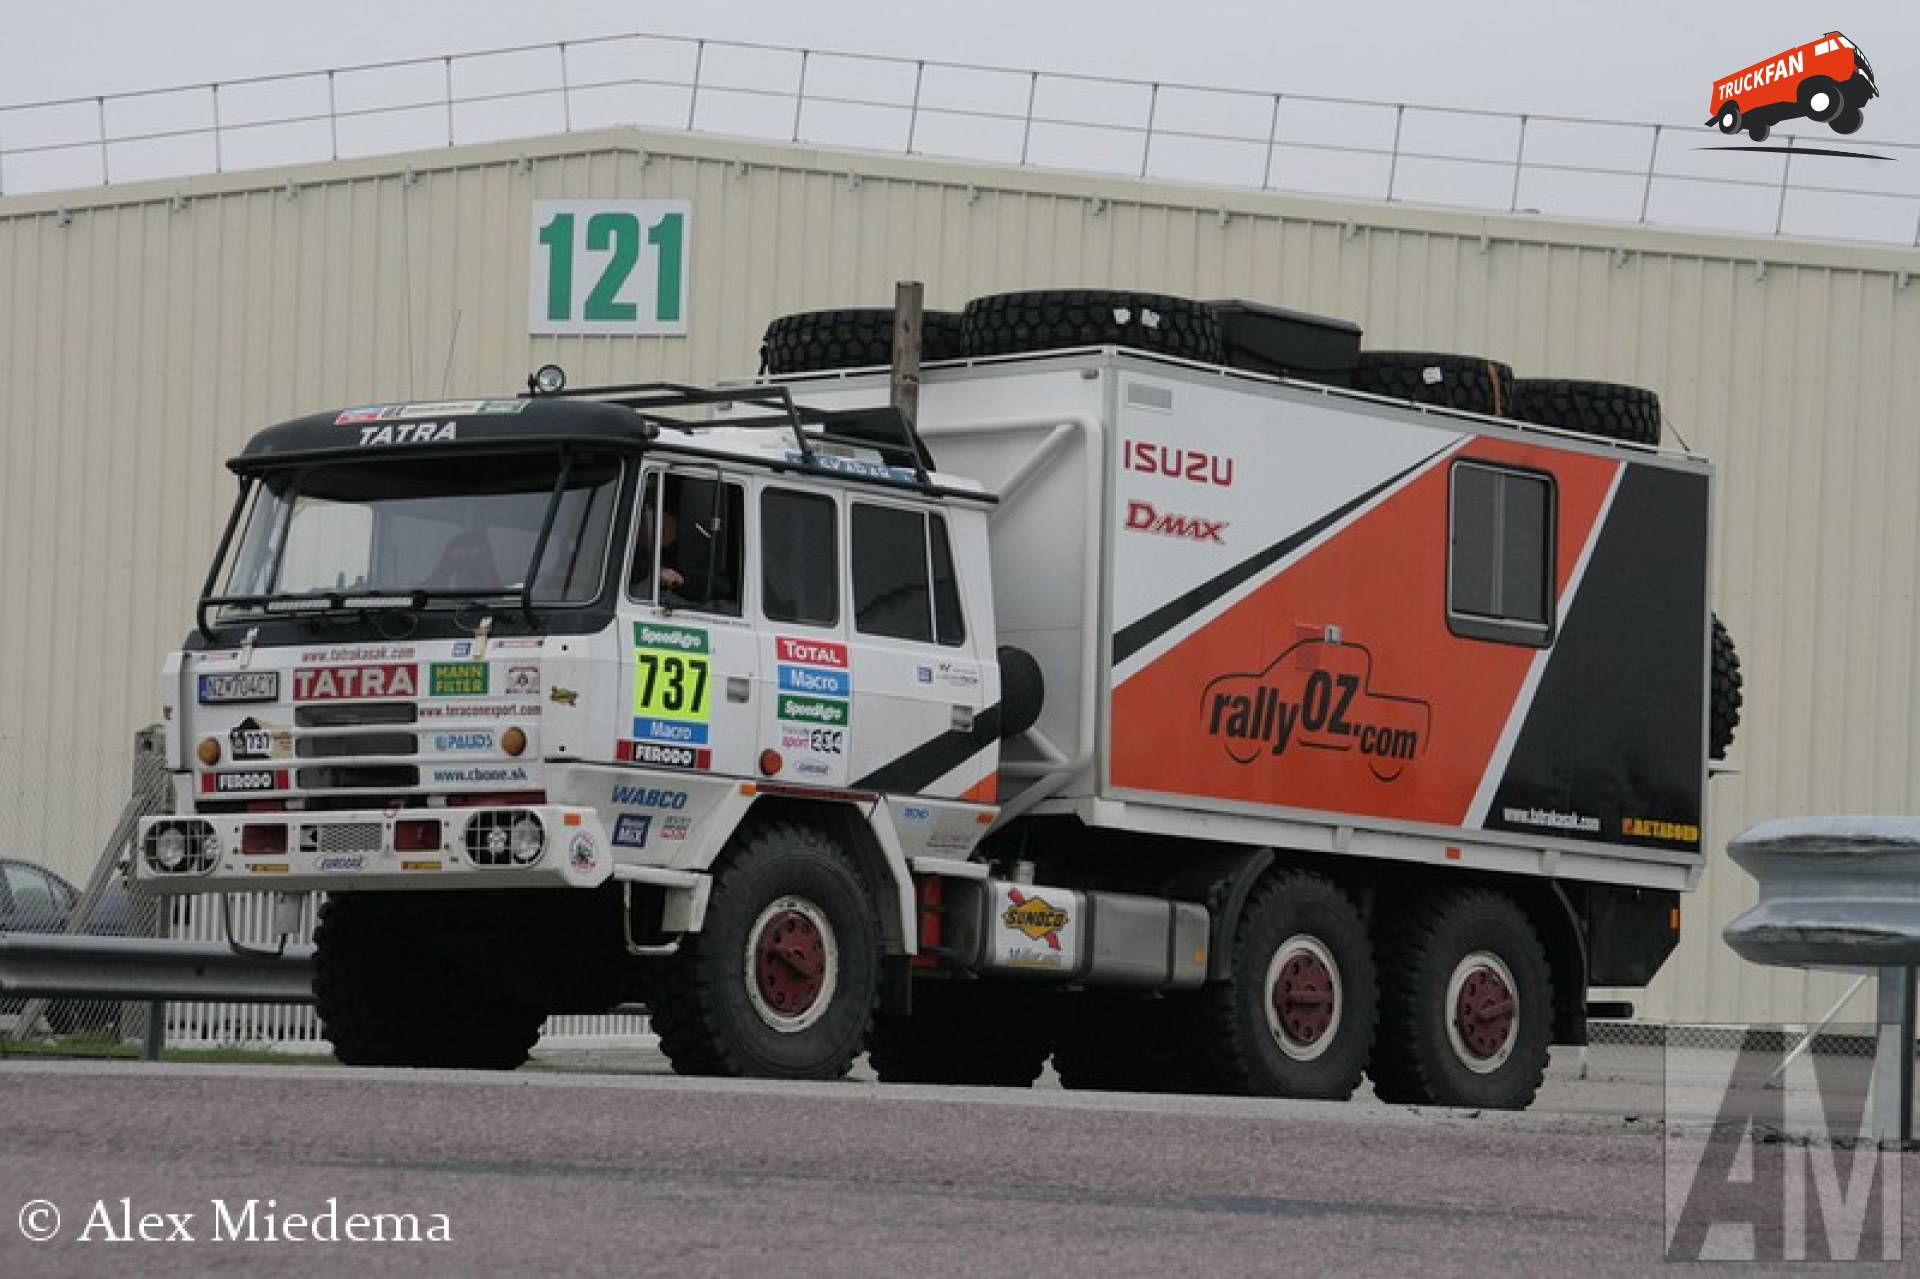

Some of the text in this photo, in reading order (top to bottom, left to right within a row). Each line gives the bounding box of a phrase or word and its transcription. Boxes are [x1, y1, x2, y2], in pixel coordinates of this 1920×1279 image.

[539, 213, 684, 320] 121
[359, 421, 457, 447] TATRA
[1124, 439, 1232, 487] ISUZU
[783, 640, 840, 662] TOTAL
[296, 664, 415, 698] TATRA
[435, 666, 483, 678] MANN
[791, 669, 838, 691] Macro
[435, 680, 483, 692] FILTER
[639, 655, 708, 713] 737
[1209, 669, 1417, 760] rallyOZ.com
[651, 721, 692, 739] Macro
[634, 745, 692, 766] FERODO
[611, 785, 688, 810] WABCO
[1005, 910, 1066, 928] SUNOCO
